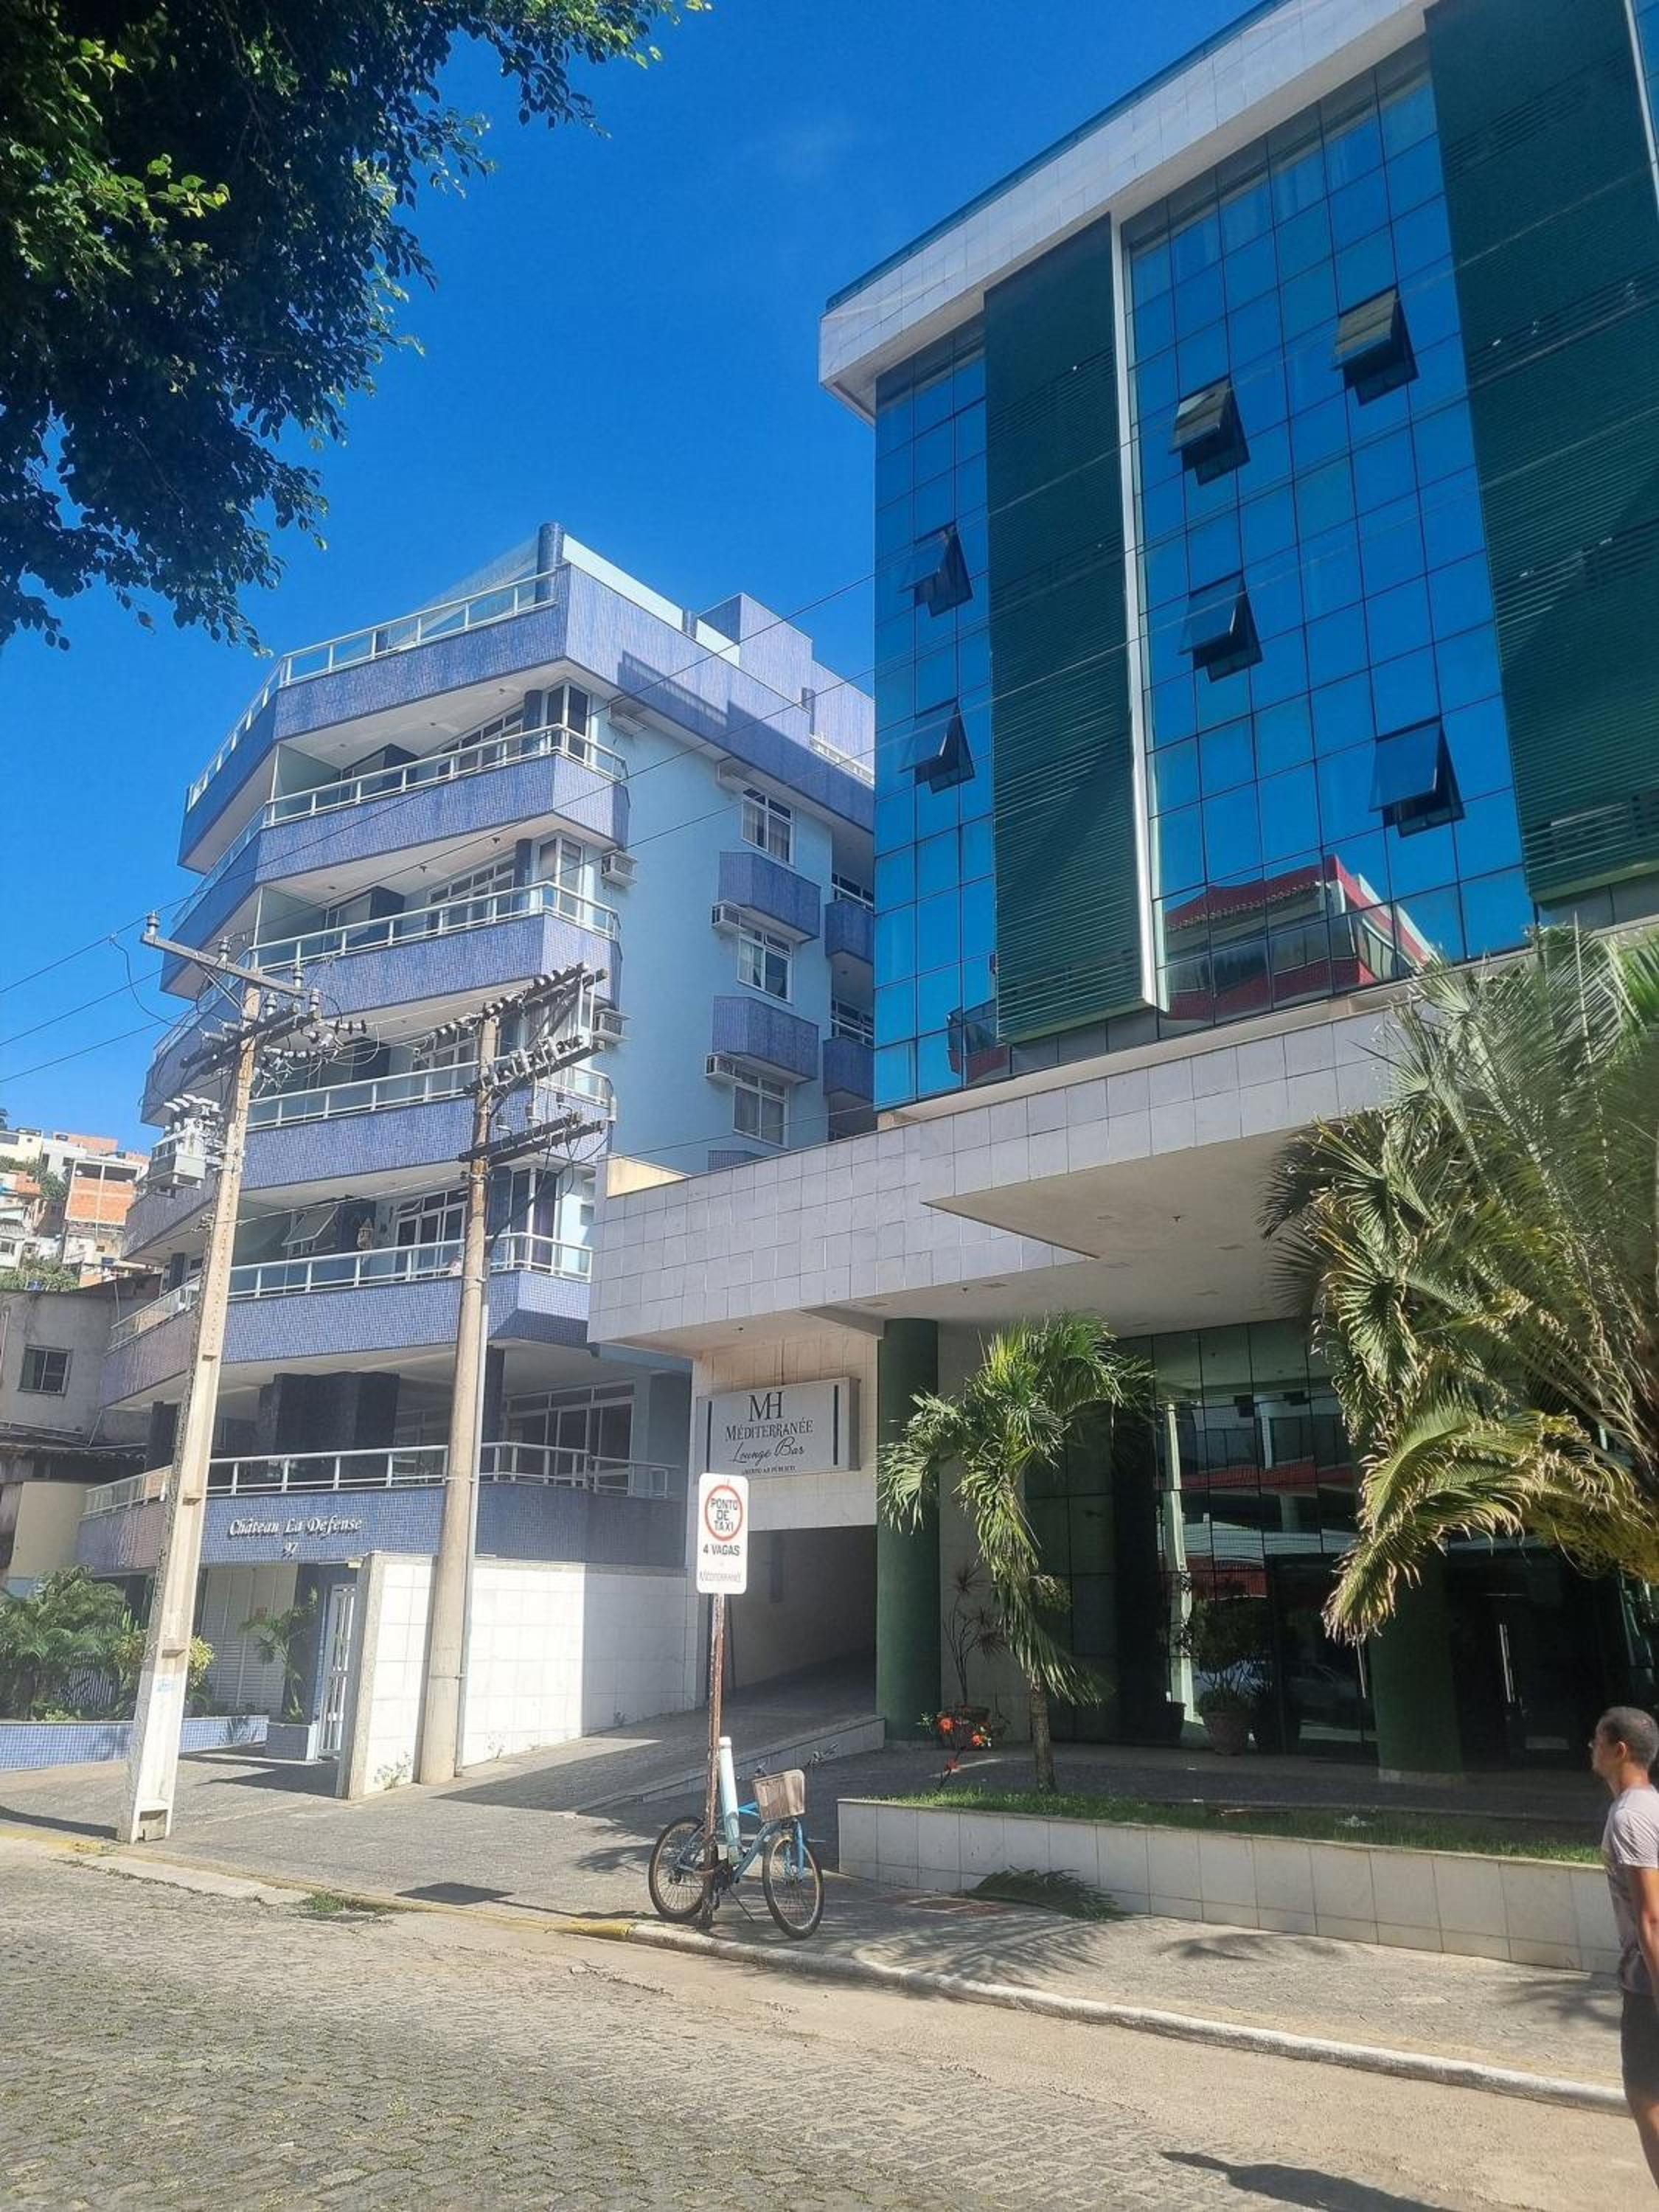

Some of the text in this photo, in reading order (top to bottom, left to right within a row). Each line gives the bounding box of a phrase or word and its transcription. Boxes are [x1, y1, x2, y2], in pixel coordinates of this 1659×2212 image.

[748, 1391, 785, 1422] MH
[725, 1417, 813, 1442] MÉDITERRANÉE
[730, 1436, 804, 1466] Lounge Bar
[710, 1498, 738, 1511] PONTO
[717, 1509, 729, 1520] DE
[285, 1517, 303, 1533] La
[714, 1520, 734, 1532] TAXI
[703, 1543, 741, 1557] 4 VAGAS
